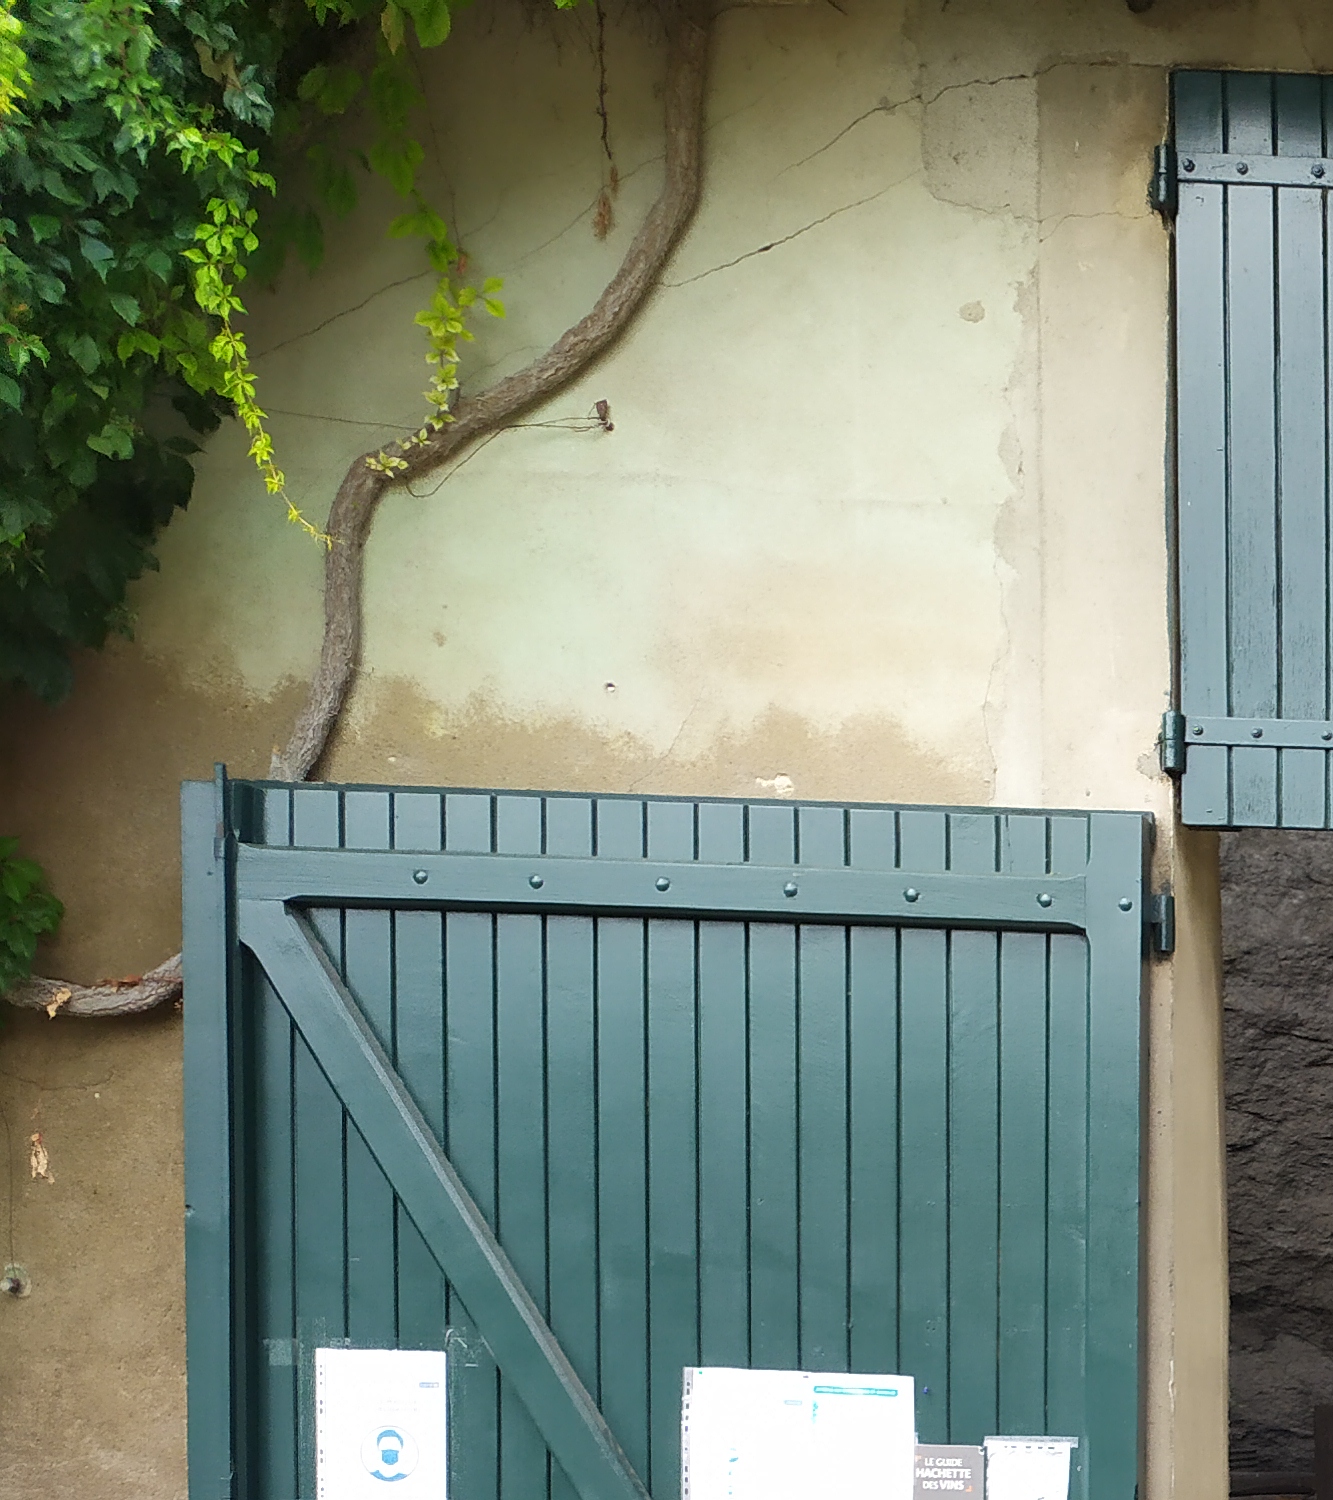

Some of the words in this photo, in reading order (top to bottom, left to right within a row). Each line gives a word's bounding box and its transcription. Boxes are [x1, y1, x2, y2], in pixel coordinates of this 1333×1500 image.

[924, 1457, 934, 1466] LE
[935, 1457, 963, 1467] GUIDE
[915, 1467, 972, 1479] HACHETTE
[922, 1480, 939, 1490] DES
[939, 1480, 965, 1491] VINS
